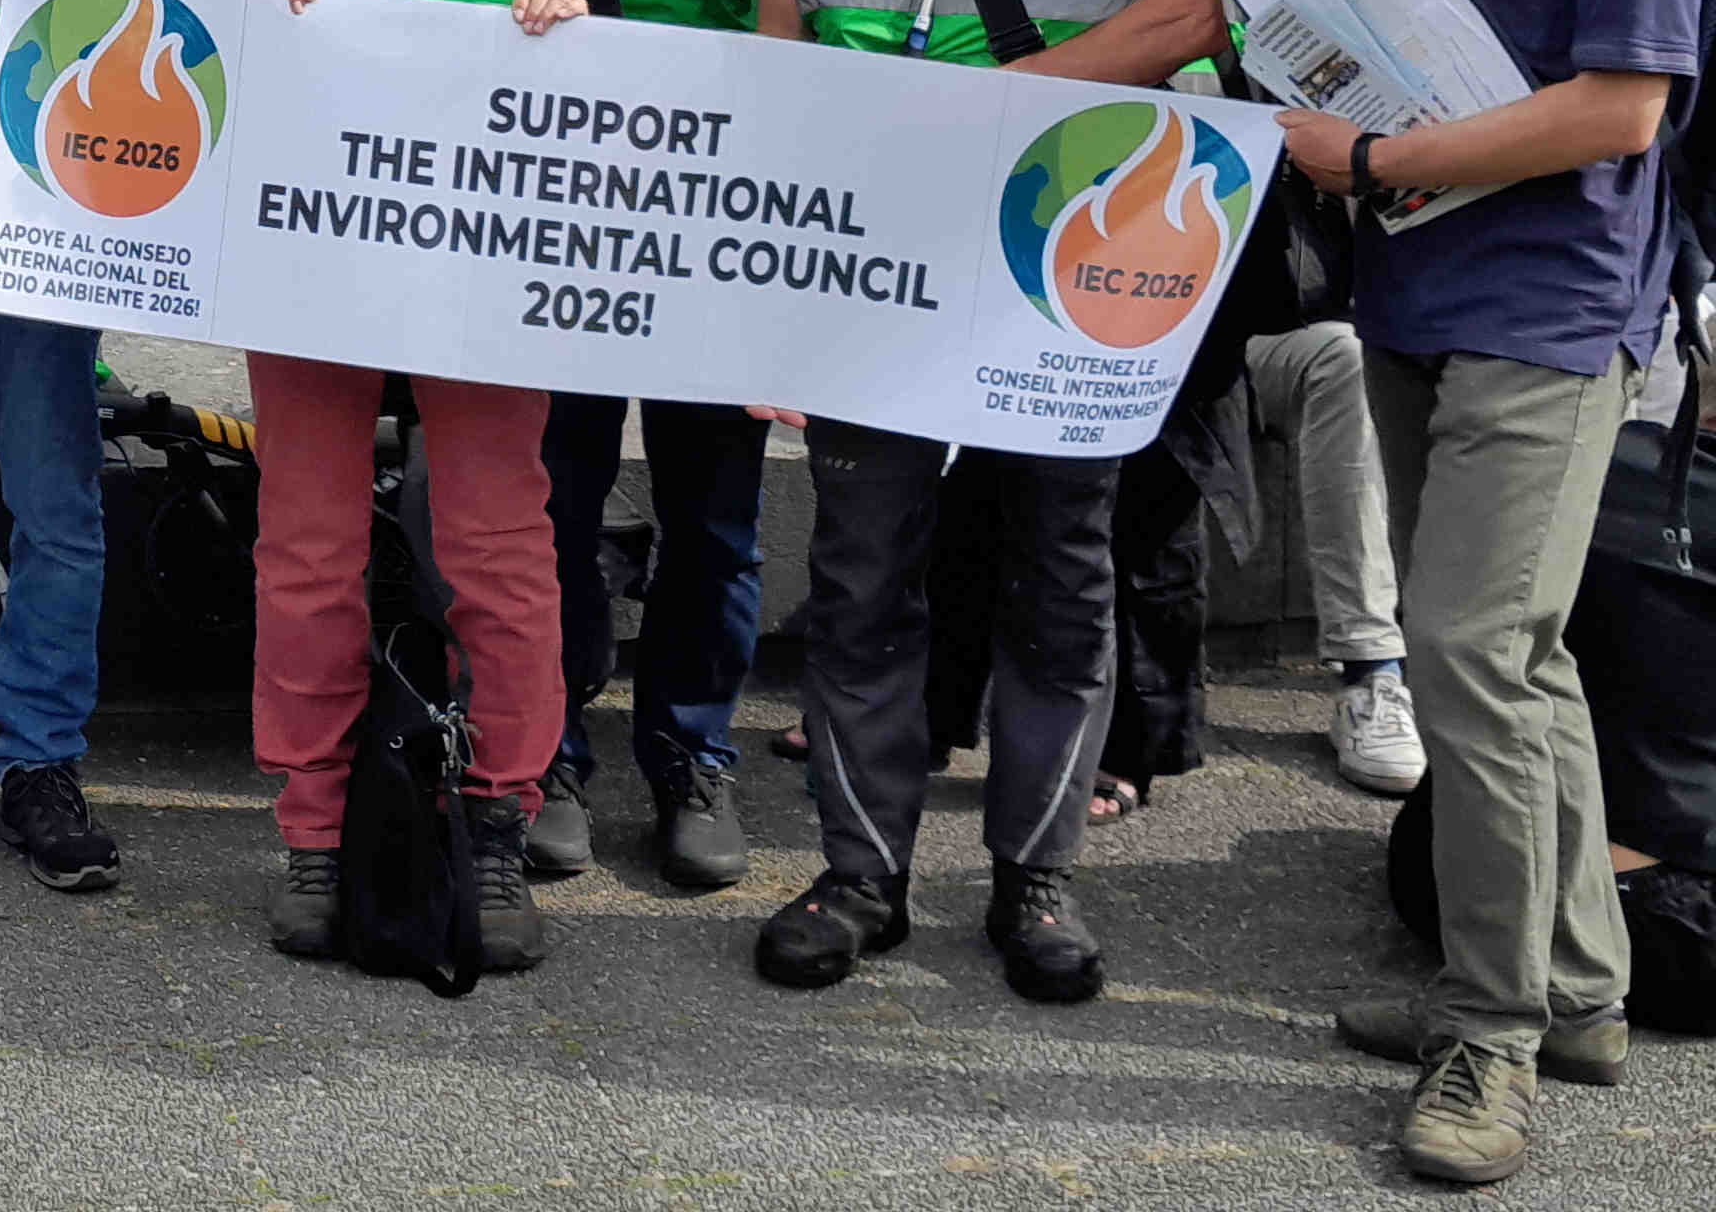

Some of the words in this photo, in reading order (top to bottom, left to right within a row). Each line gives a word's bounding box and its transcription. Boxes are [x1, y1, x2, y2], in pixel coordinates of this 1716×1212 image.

[487, 87, 733, 157] SUPPORT
[63, 132, 108, 163] IEC
[113, 138, 181, 172] 2026
[340, 131, 437, 187] THE
[452, 145, 866, 237] INTERNATIONAL
[70, 233, 95, 254] AL
[101, 237, 192, 267] CONSEJO
[258, 183, 693, 278] ENVIRONMENTAL
[707, 236, 939, 311] COUNCIL
[42, 279, 145, 310] AMBIENTE
[148, 293, 201, 318] 2026!
[152, 268, 191, 292] DEL
[1074, 262, 1124, 294] IEC
[1130, 271, 1198, 300] 2026
[522, 280, 656, 338] 2026!
[976, 365, 1058, 394] CONSEIL
[1038, 351, 1135, 376] SOUTENEZ
[1138, 359, 1158, 376] LE
[986, 391, 1014, 412] DE
[1058, 425, 1105, 444] 2026!
